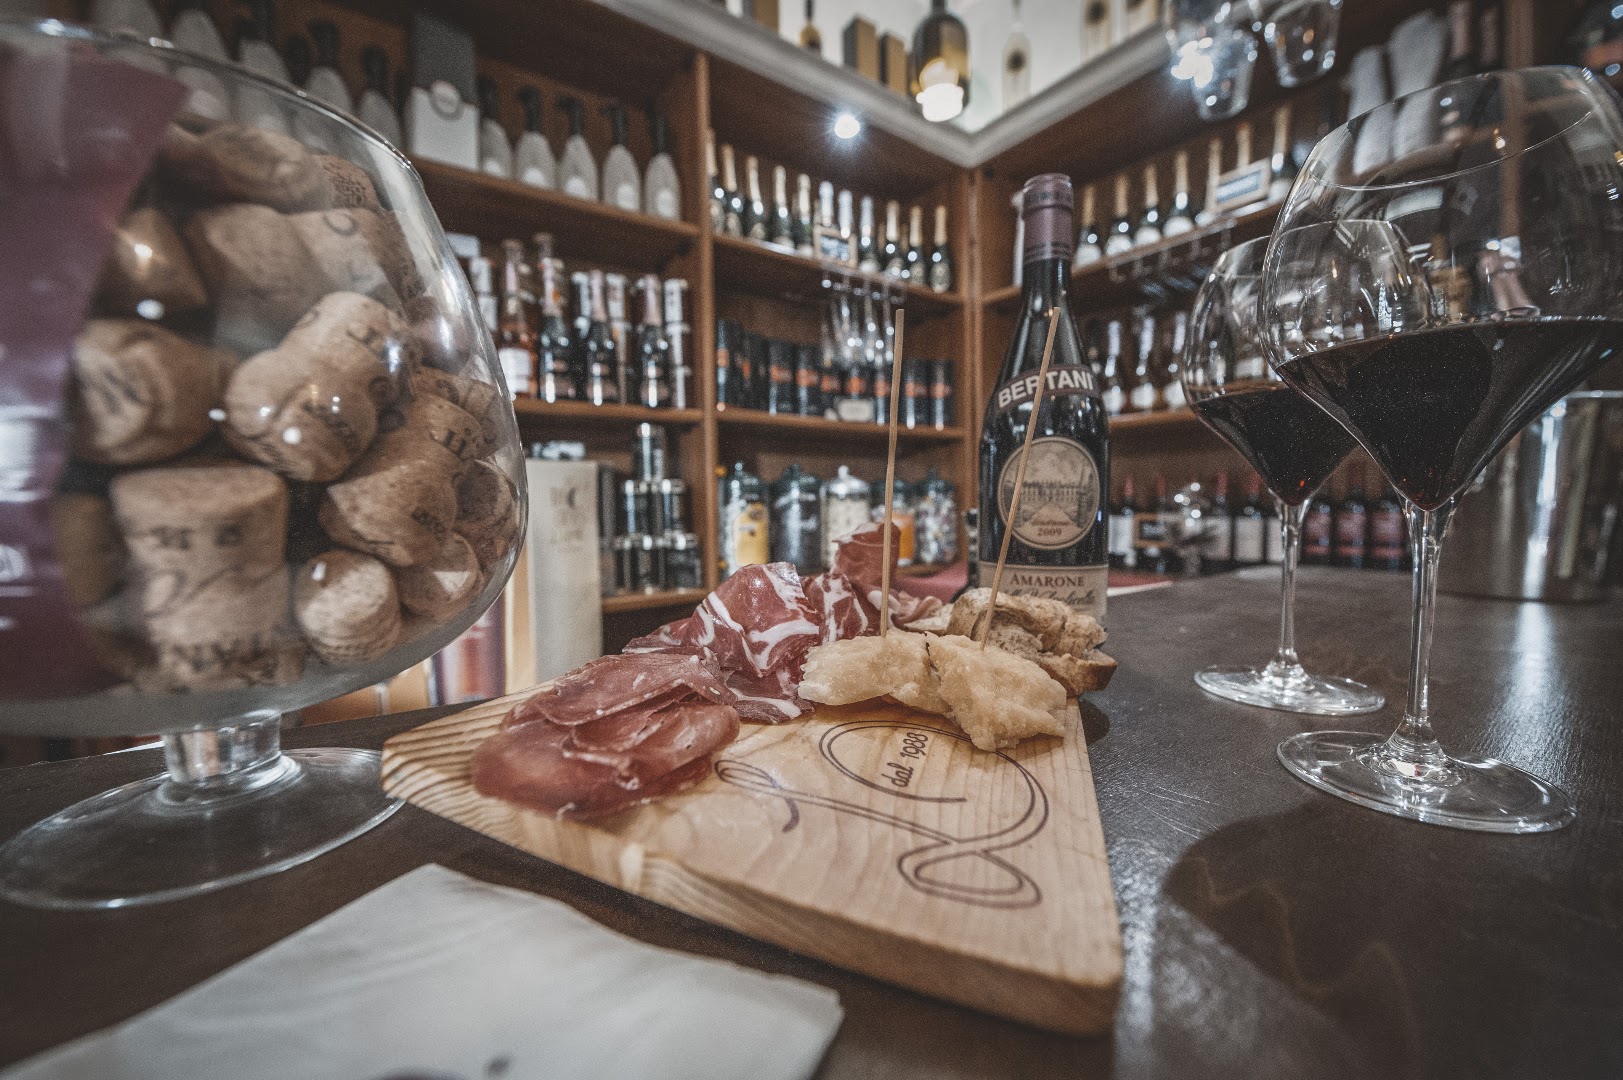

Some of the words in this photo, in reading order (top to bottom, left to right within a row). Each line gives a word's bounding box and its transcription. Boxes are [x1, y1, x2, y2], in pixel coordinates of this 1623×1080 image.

[998, 369, 1094, 408] BERTANI
[1009, 573, 1085, 588] AMARONE
[881, 762, 915, 788] dal
[900, 732, 929, 760] 1988
